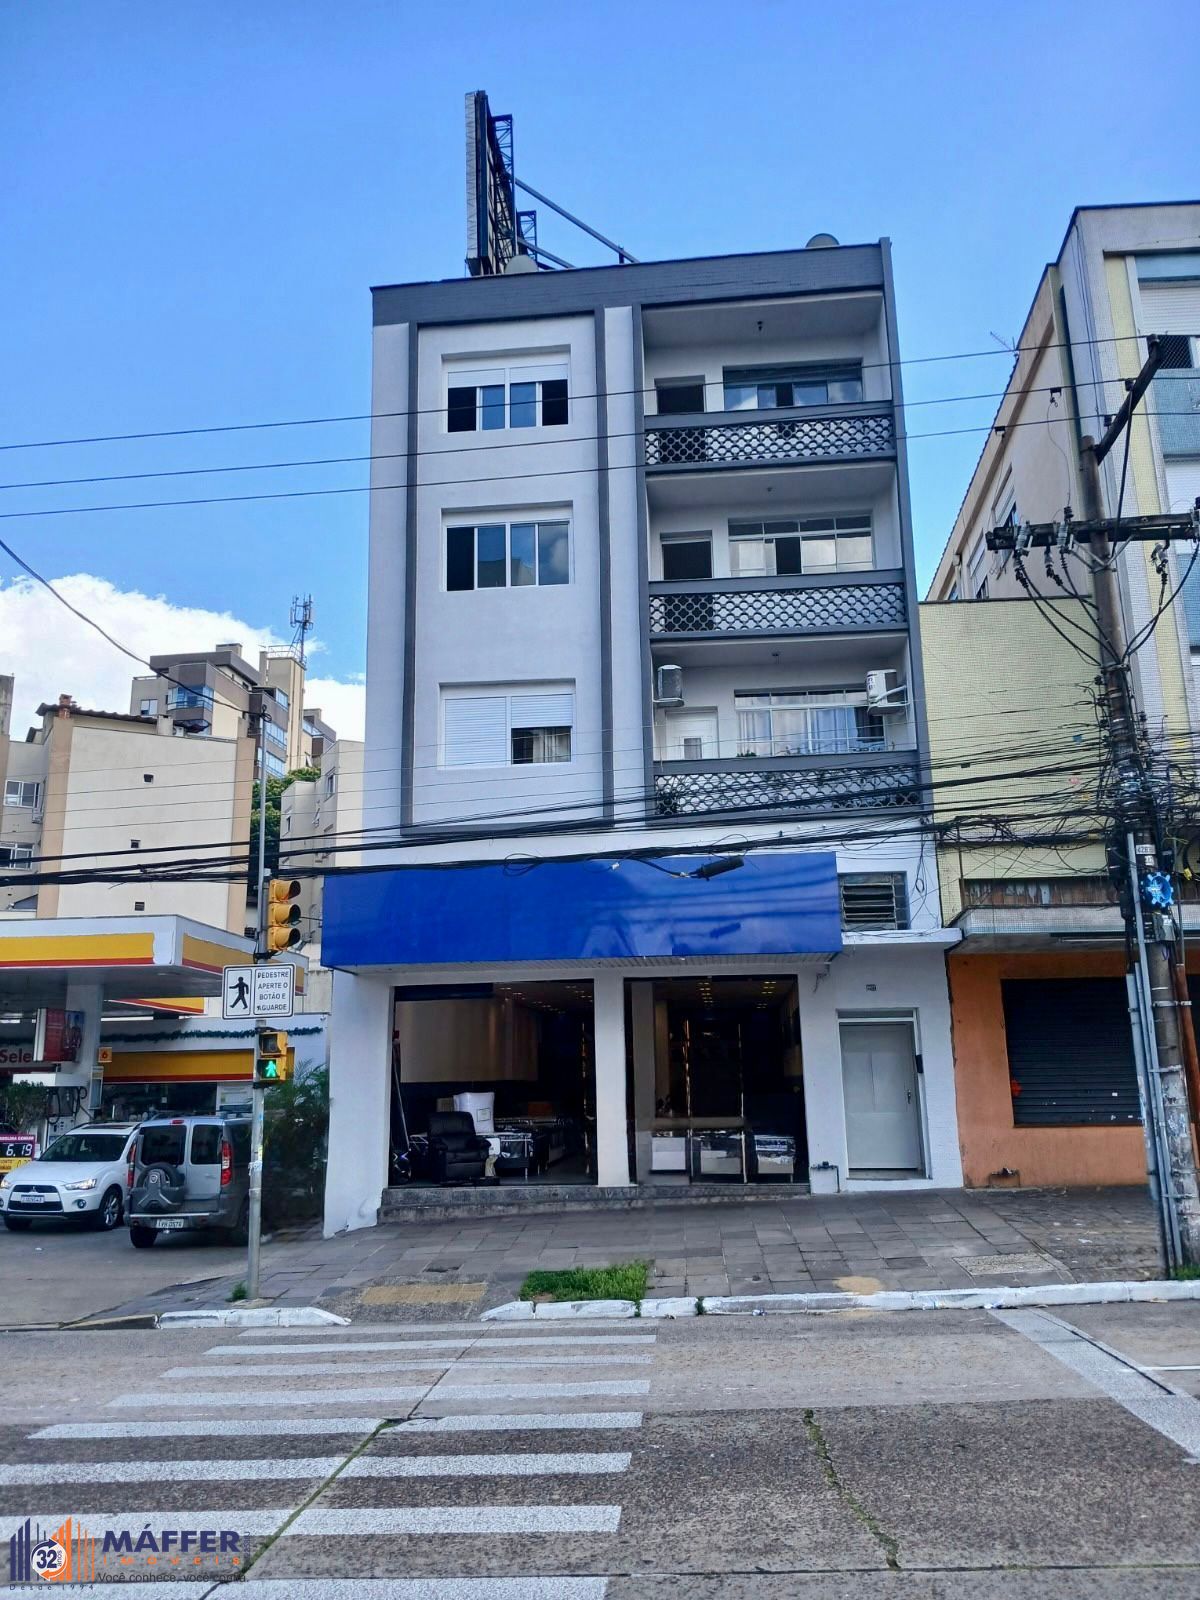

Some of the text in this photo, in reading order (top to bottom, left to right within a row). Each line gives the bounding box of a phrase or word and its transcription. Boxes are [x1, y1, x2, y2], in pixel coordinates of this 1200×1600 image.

[257, 971, 289, 979] PEDESTRE
[258, 982, 281, 990] APERTE
[259, 992, 280, 1001] BOTÃO
[6, 1143, 33, 1157] 6.19
